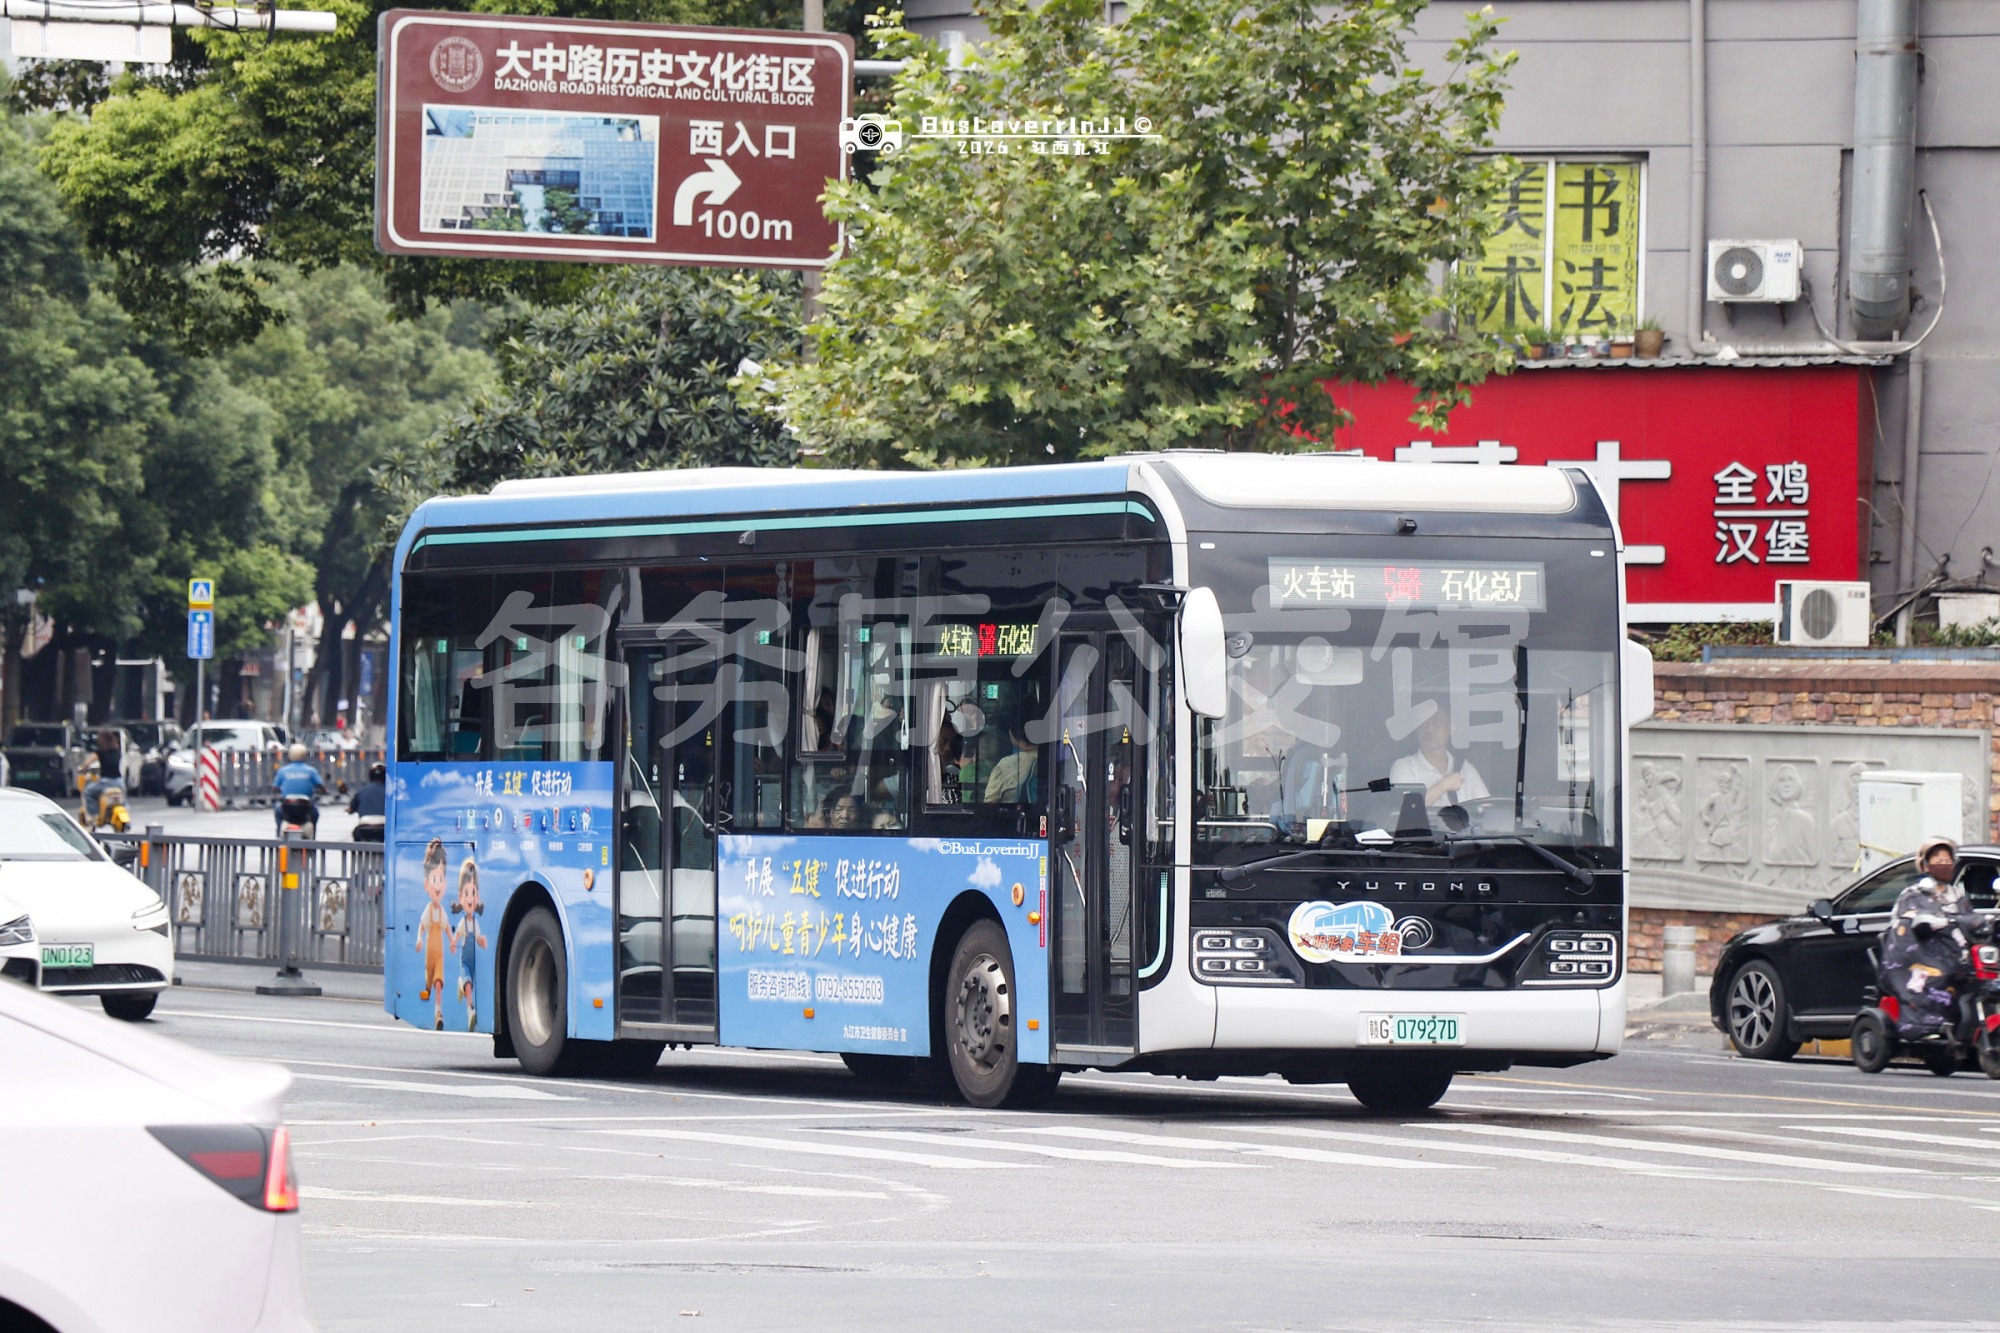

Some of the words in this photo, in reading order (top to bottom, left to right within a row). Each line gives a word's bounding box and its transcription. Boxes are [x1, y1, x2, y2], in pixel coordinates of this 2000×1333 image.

[495, 40, 815, 93] 大中路历史文化街区
[494, 78, 557, 93] DAZHONG
[560, 82, 596, 95] ROAD
[597, 83, 673, 100] HISTORICAL
[675, 87, 701, 101] AND
[703, 89, 769, 104] CULTURAL
[772, 92, 815, 106] BLOCK
[689, 119, 796, 159] 西入口
[698, 209, 793, 241] 100m
[1559, 168, 1622, 328] 书法
[1713, 460, 1810, 505] 全鸡
[1714, 519, 1811, 565] 汉堡
[1282, 565, 1356, 600] 火车站
[1384, 565, 1423, 601] 5路
[1440, 569, 1538, 602] 石化总厂
[939, 624, 973, 658] 火车站
[978, 623, 997, 657] 5路
[998, 624, 1039, 655] 石化总厂
[475, 769, 494, 797] 开展
[531, 769, 572, 797] 促进行动
[745, 856, 776, 897] 开展
[782, 858, 828, 898] “五健”
[835, 858, 900, 900] 促进行动
[1337, 881, 1491, 891] YUTONG
[729, 908, 918, 960] 呵护儿童青少年身心健康
[1297, 930, 1400, 955] 文明形象车组
[816, 977, 883, 1001] 0792-8552603
